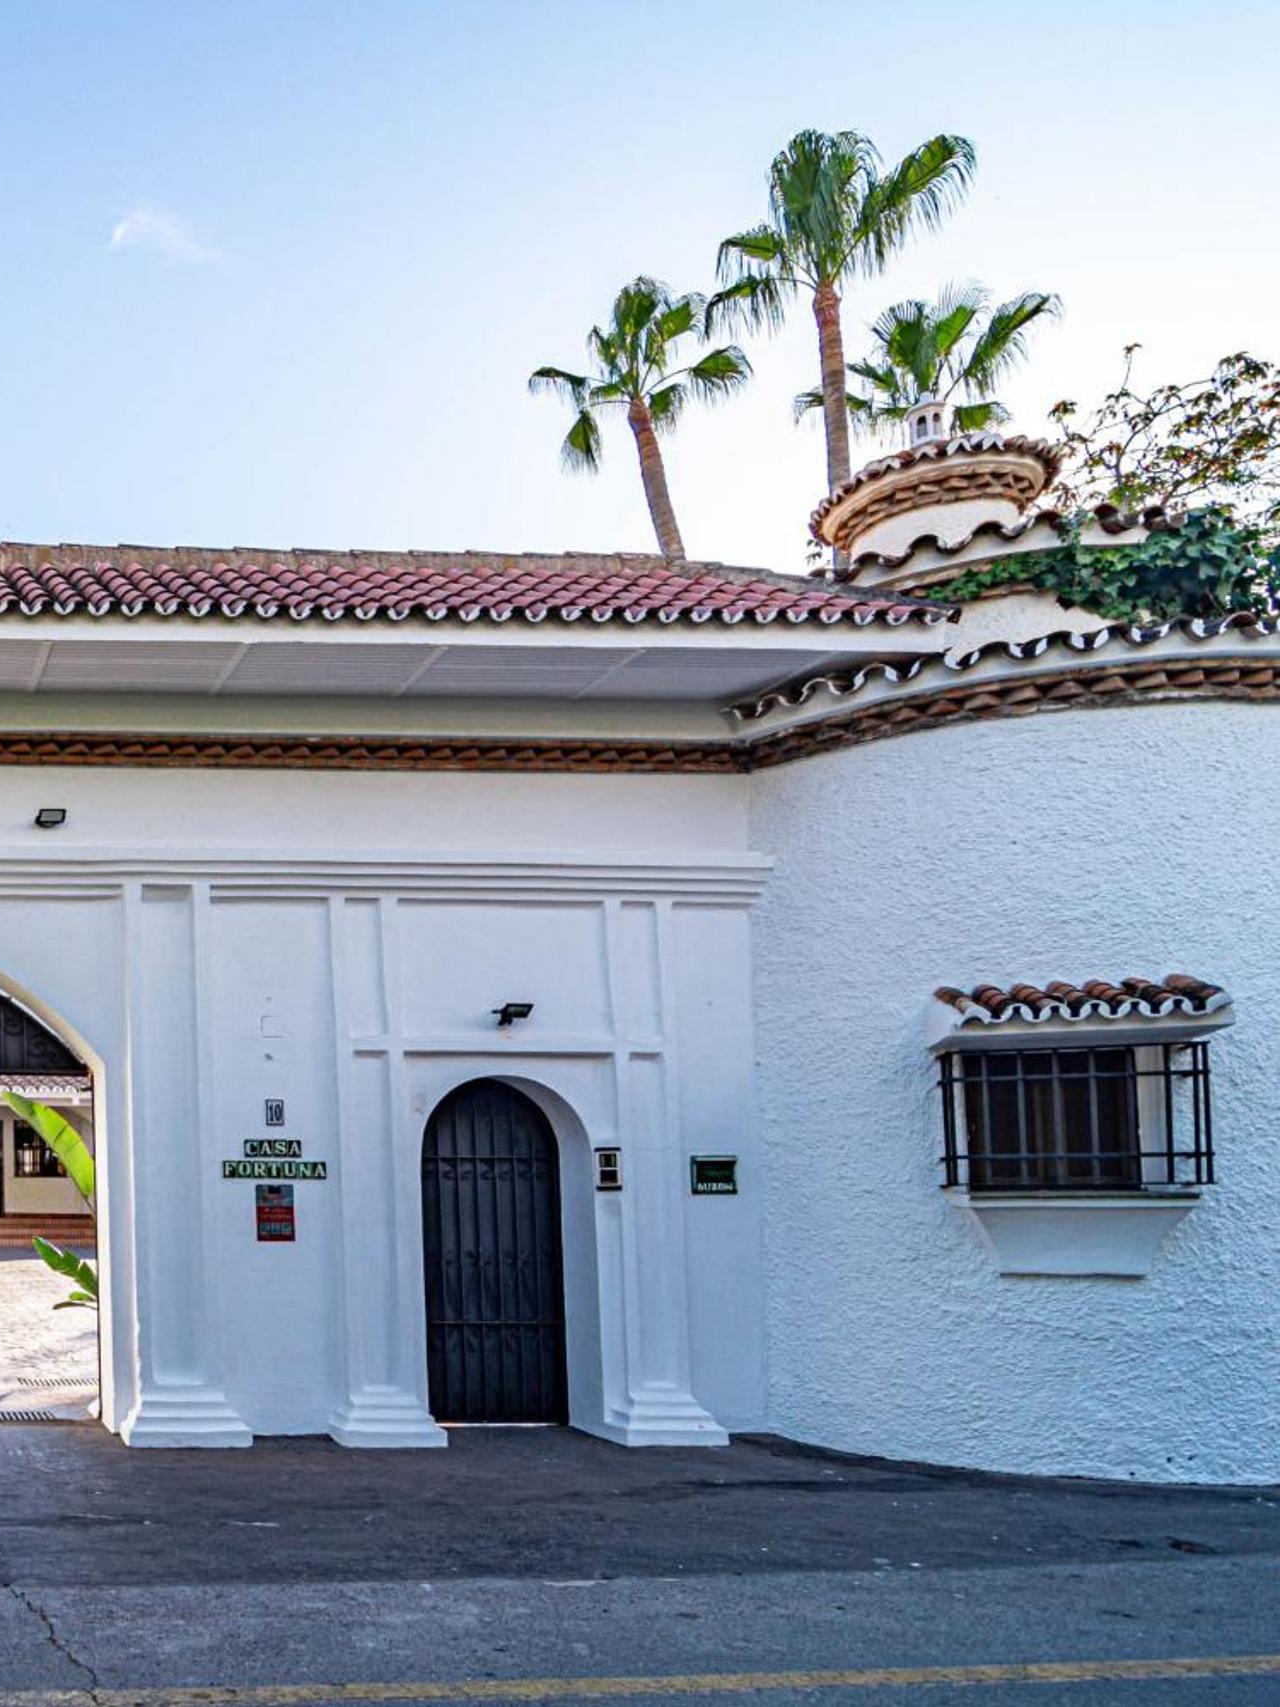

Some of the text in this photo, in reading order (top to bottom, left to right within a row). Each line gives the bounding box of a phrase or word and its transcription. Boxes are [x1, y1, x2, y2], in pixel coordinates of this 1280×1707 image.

[269, 1104, 281, 1121] 10
[246, 1141, 300, 1155] CASA
[224, 1162, 325, 1177] FORTUNA
